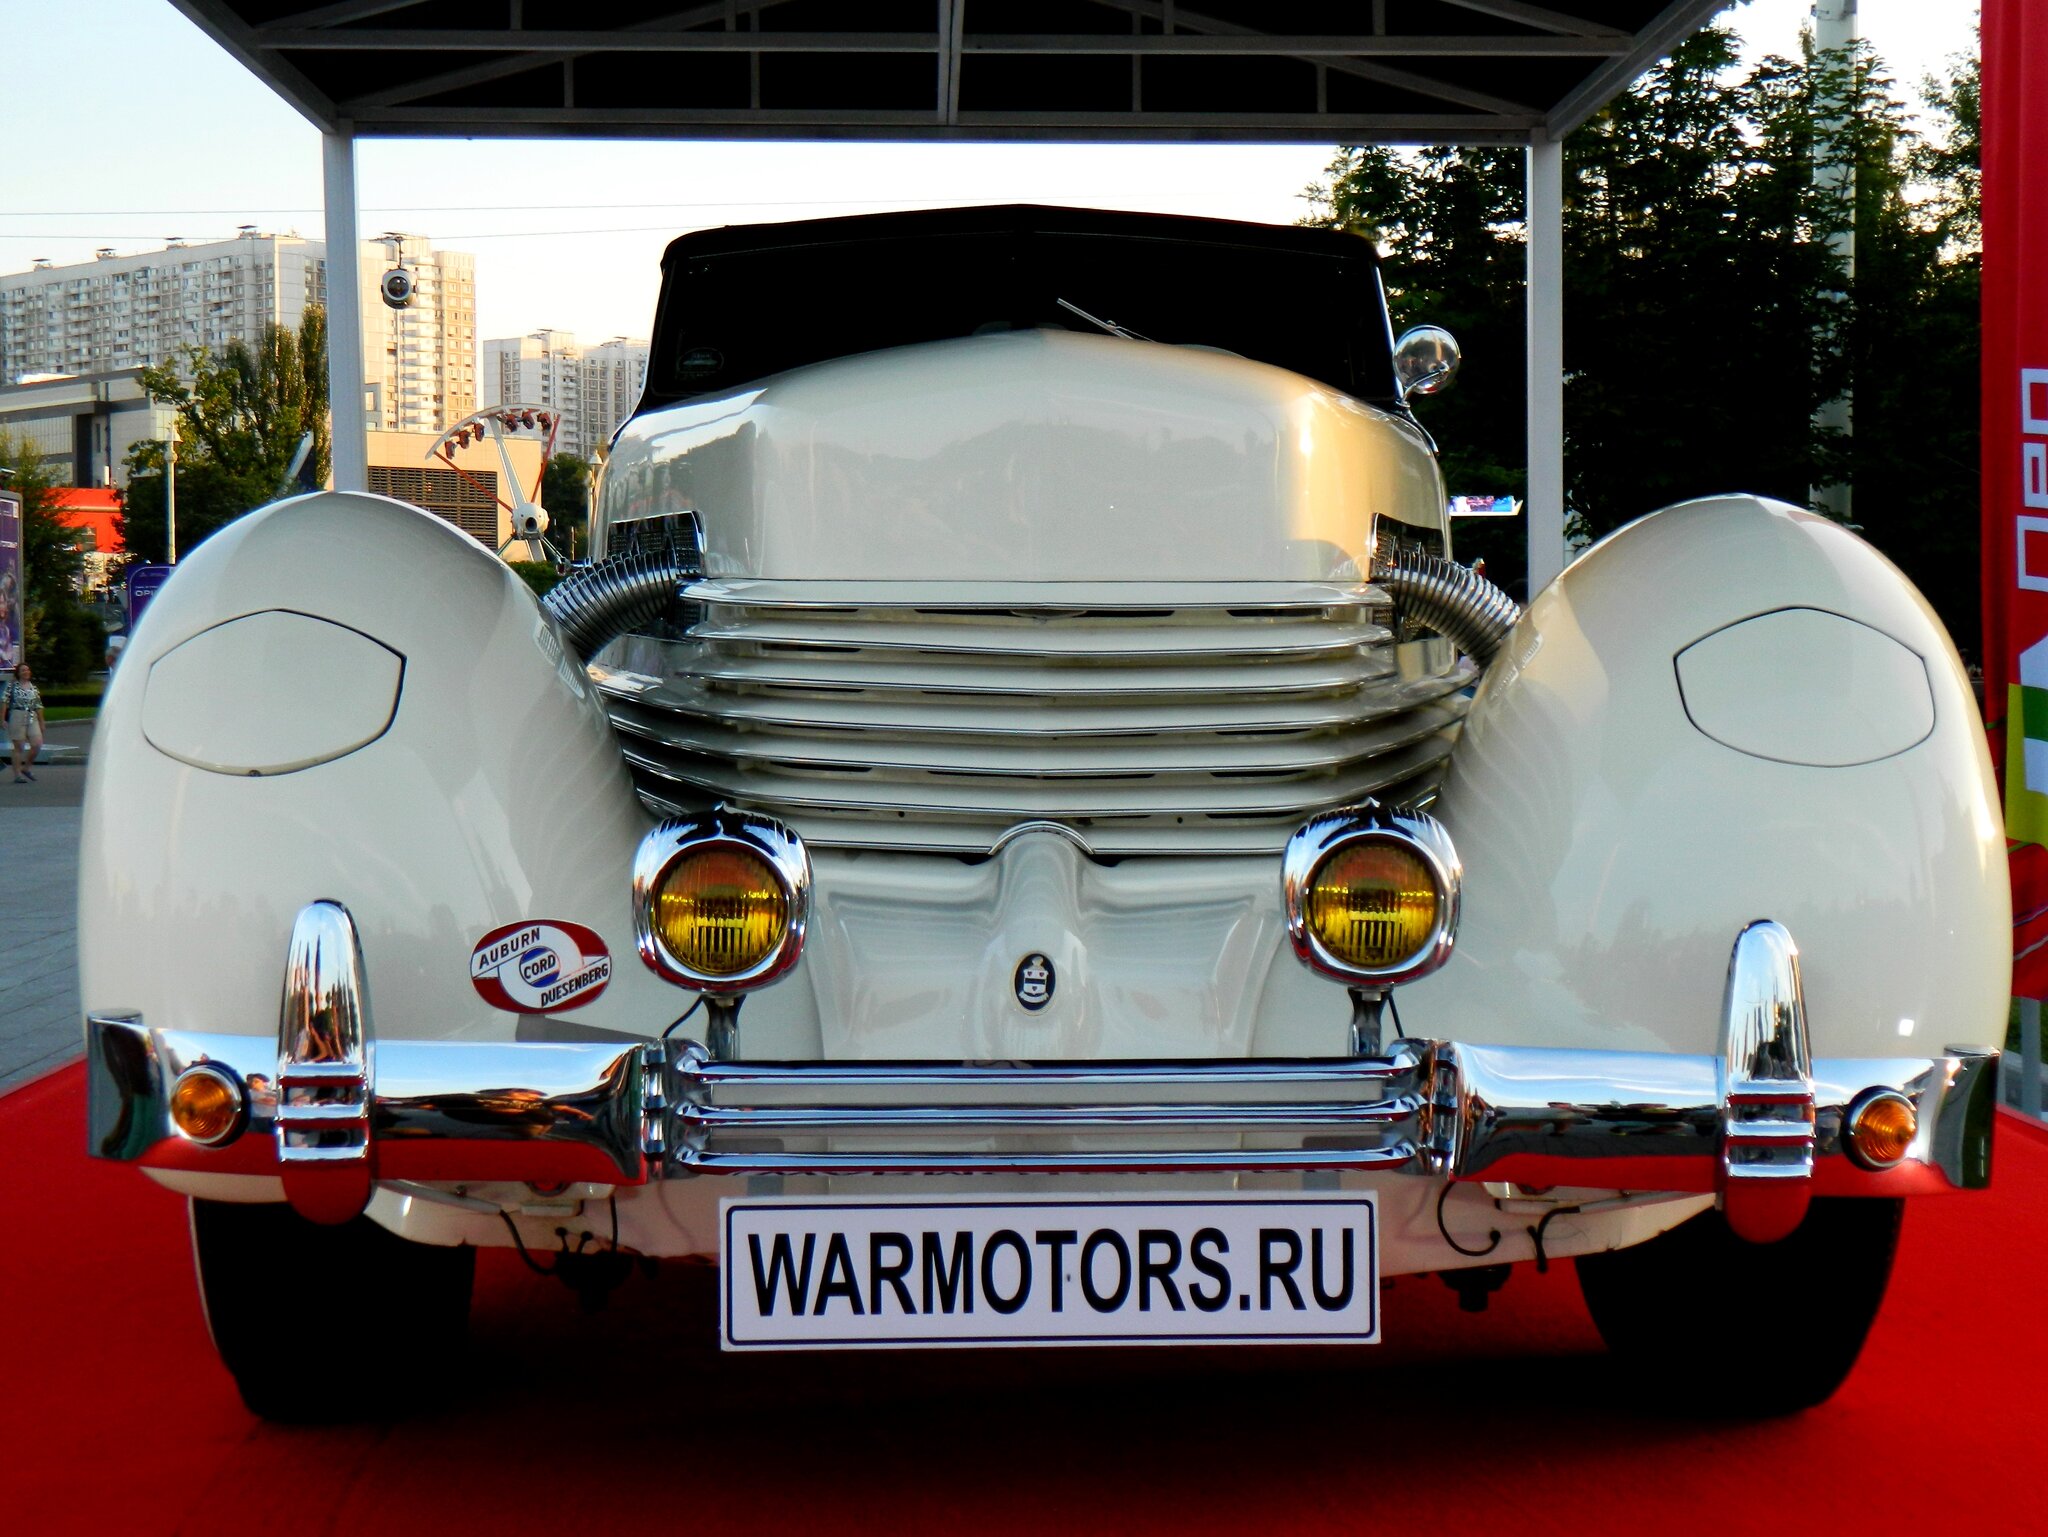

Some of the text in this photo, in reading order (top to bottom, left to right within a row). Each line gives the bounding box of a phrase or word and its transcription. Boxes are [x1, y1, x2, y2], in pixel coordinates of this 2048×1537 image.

[479, 927, 541, 970] AUBURN
[523, 954, 556, 980] CORD
[540, 963, 608, 1008] DUESENBERG
[747, 1227, 1354, 1317] WARMOTORS.RU
